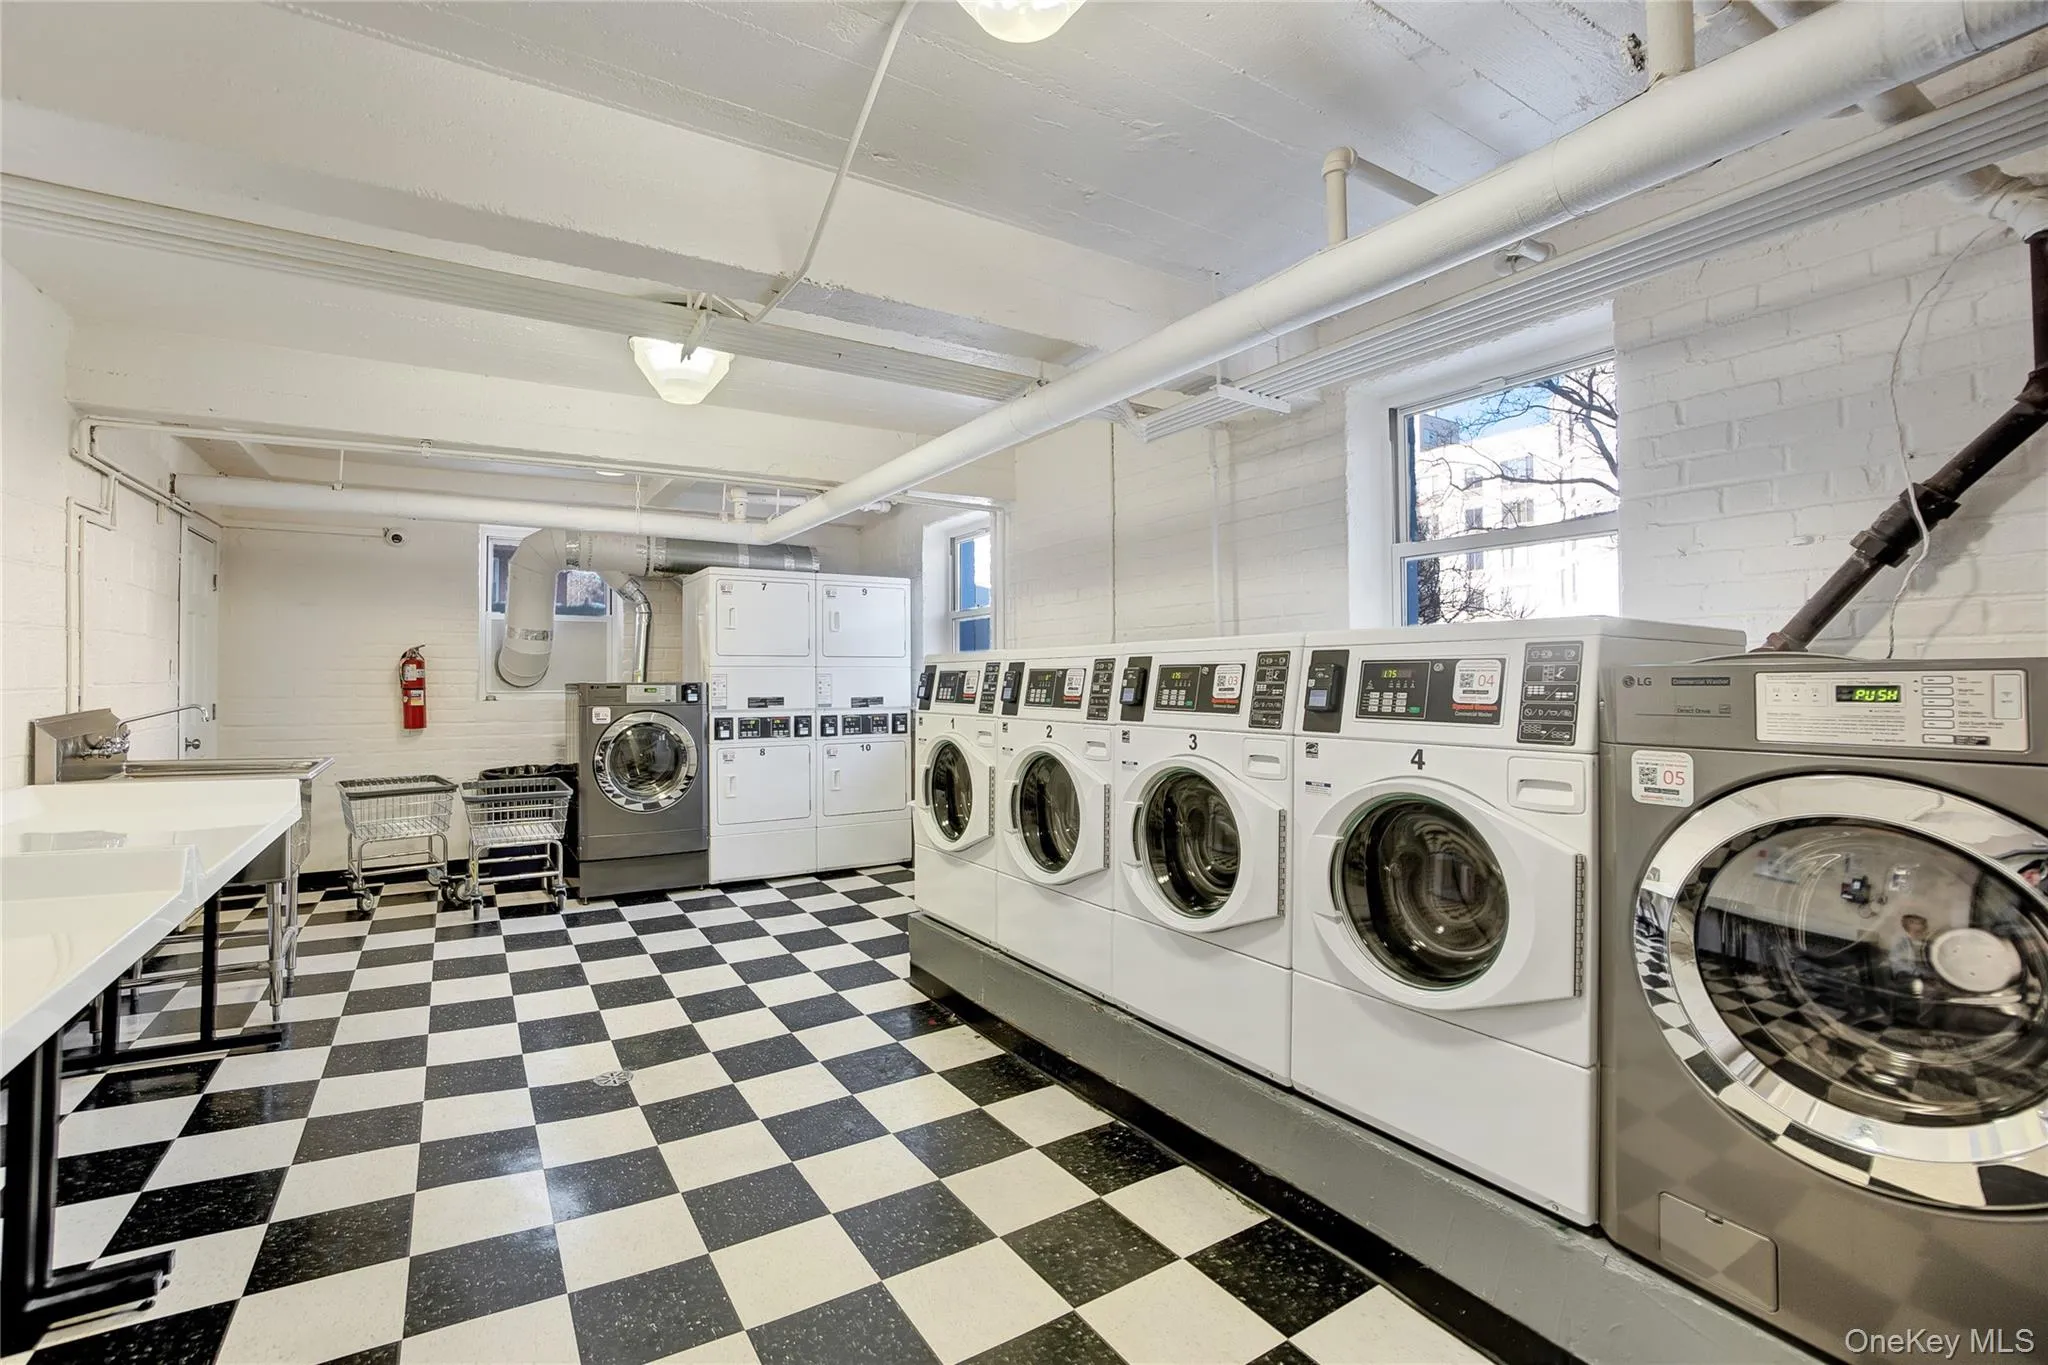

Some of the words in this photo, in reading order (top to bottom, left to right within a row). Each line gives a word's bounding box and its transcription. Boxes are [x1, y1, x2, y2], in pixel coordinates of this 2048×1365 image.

[761, 583, 767, 591] 7
[1478, 674, 1495, 687] 04
[1637, 677, 1652, 686] LG
[1855, 690, 1898, 701] PUSH
[951, 717, 955, 729] 1
[1046, 725, 1053, 738] 2
[860, 743, 871, 751] 10
[1189, 734, 1198, 750] 3
[760, 748, 766, 756] 8
[1410, 749, 1426, 770] 4
[1663, 770, 1685, 786] 05
